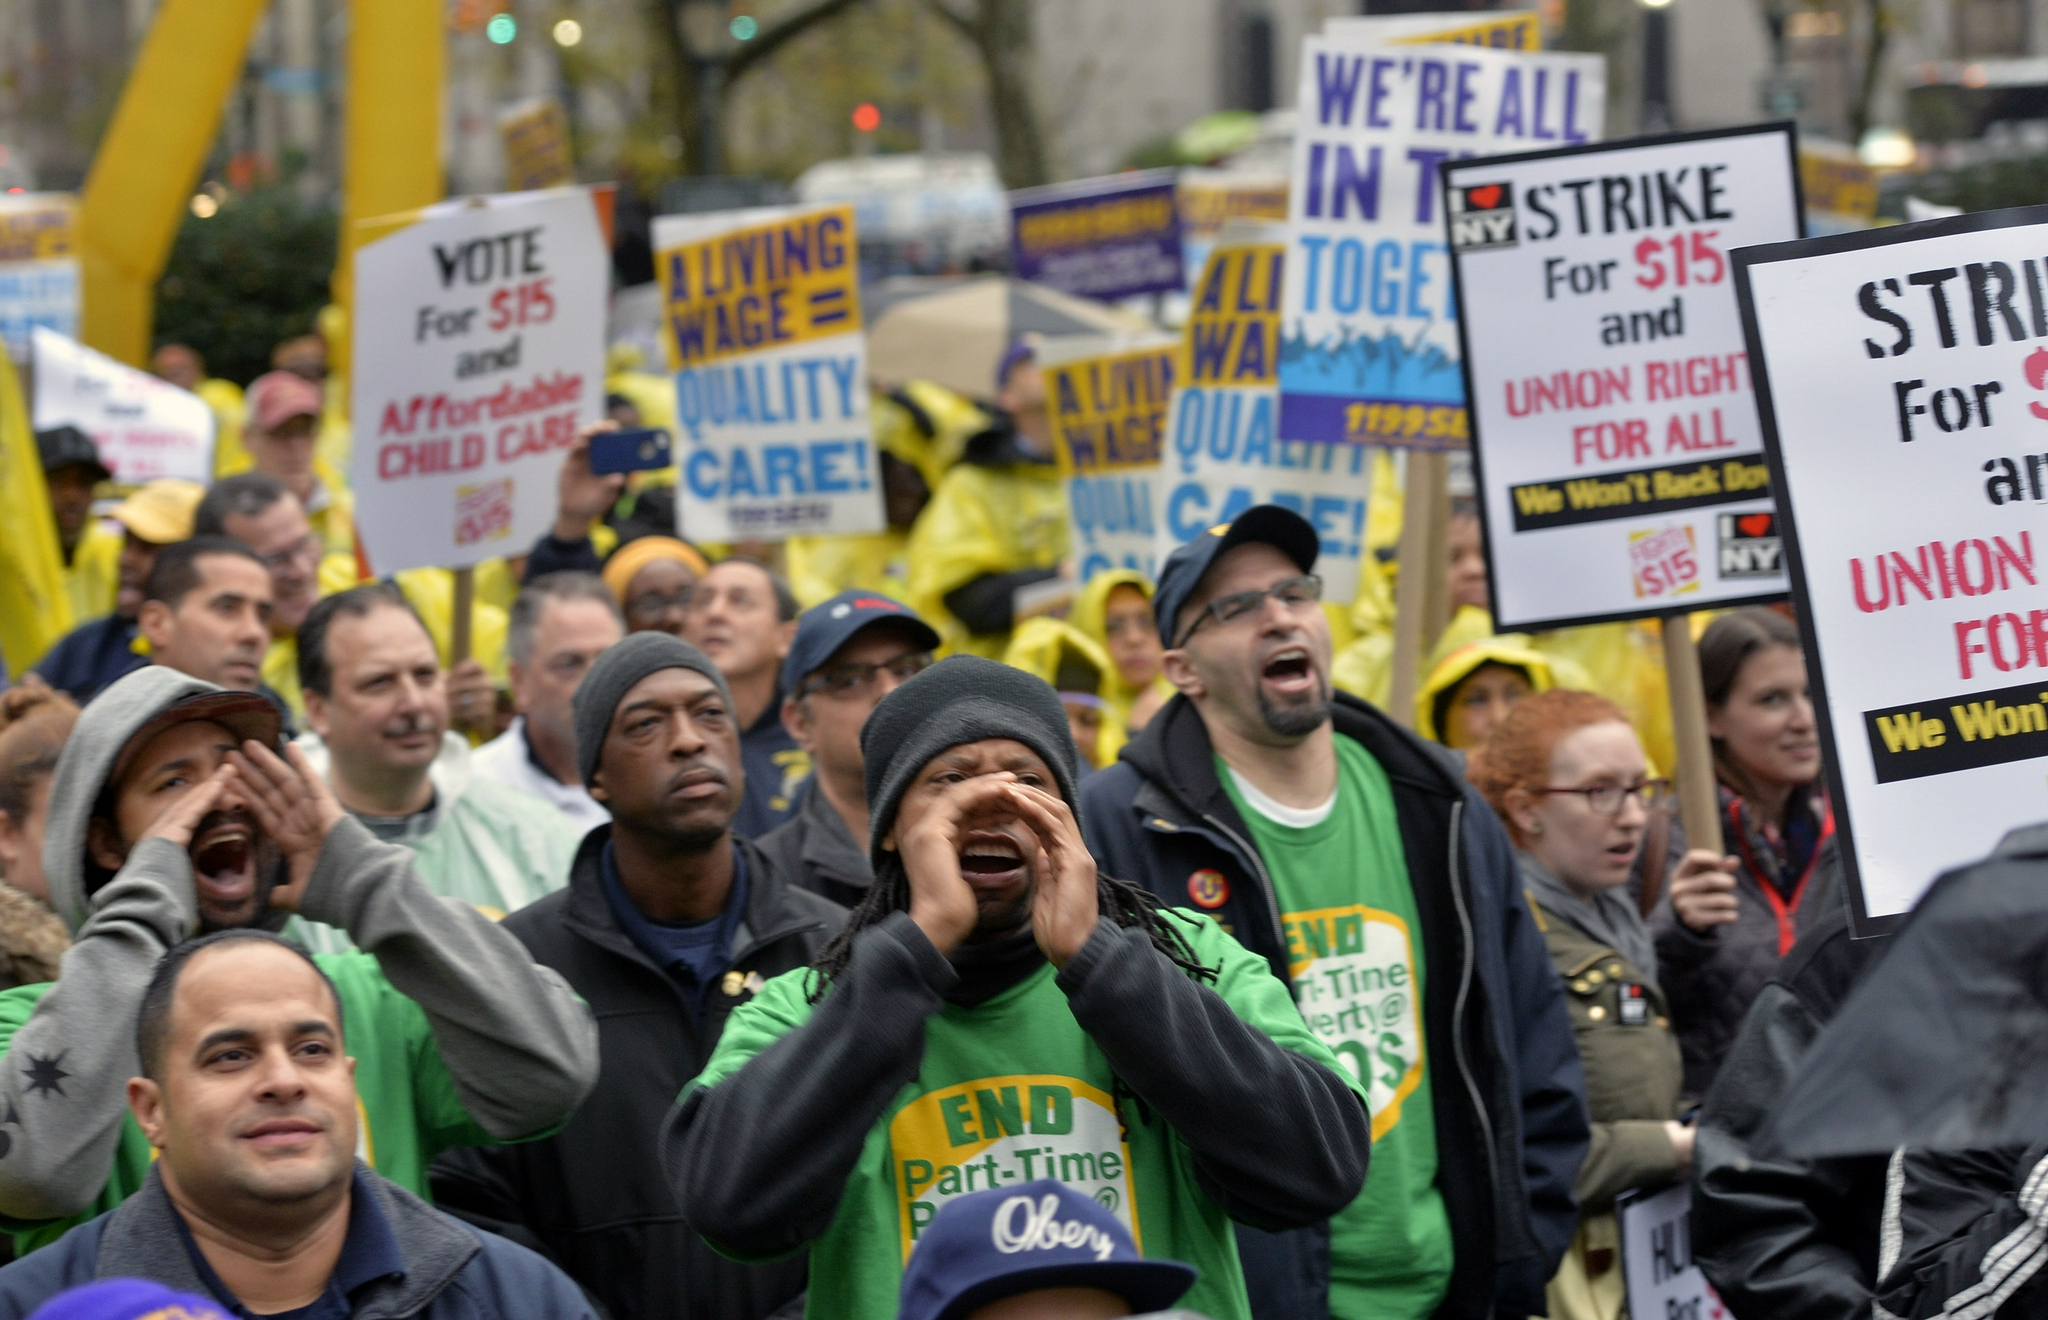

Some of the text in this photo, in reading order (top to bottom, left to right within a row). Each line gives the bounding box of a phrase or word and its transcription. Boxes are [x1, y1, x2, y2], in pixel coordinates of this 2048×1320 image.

[1316, 50, 1588, 144] WE'RE ALL
[1305, 142, 1383, 222] IN
[1526, 164, 1733, 241] STRIKE
[430, 225, 546, 289] VOTE
[671, 215, 845, 304] A LIVING
[1453, 218, 1513, 247] NY
[1199, 254, 1225, 315] A
[1545, 231, 1726, 300] For $15
[415, 304, 477, 342] For
[672, 288, 795, 362] WAGE
[1601, 296, 1686, 346] and
[1857, 253, 2048, 360] STRI
[456, 335, 522, 381] and
[677, 357, 856, 440] QUALITY
[1057, 370, 1082, 416] A
[1505, 364, 1633, 419] UNION
[1894, 378, 2003, 443] For
[376, 409, 580, 481] CHILD CARE
[1572, 407, 1737, 466] FOR ALL
[683, 441, 870, 500] CARE!
[1514, 484, 1565, 516] We
[1565, 472, 1650, 509] Won't
[1651, 464, 1722, 501] Back
[1720, 543, 1780, 571] NY
[1848, 530, 2037, 614] UNION
[1875, 711, 1947, 754] We
[938, 1085, 1074, 1148] END
[902, 1148, 1122, 1198] Part-Time
[991, 1193, 1115, 1262] Obey
